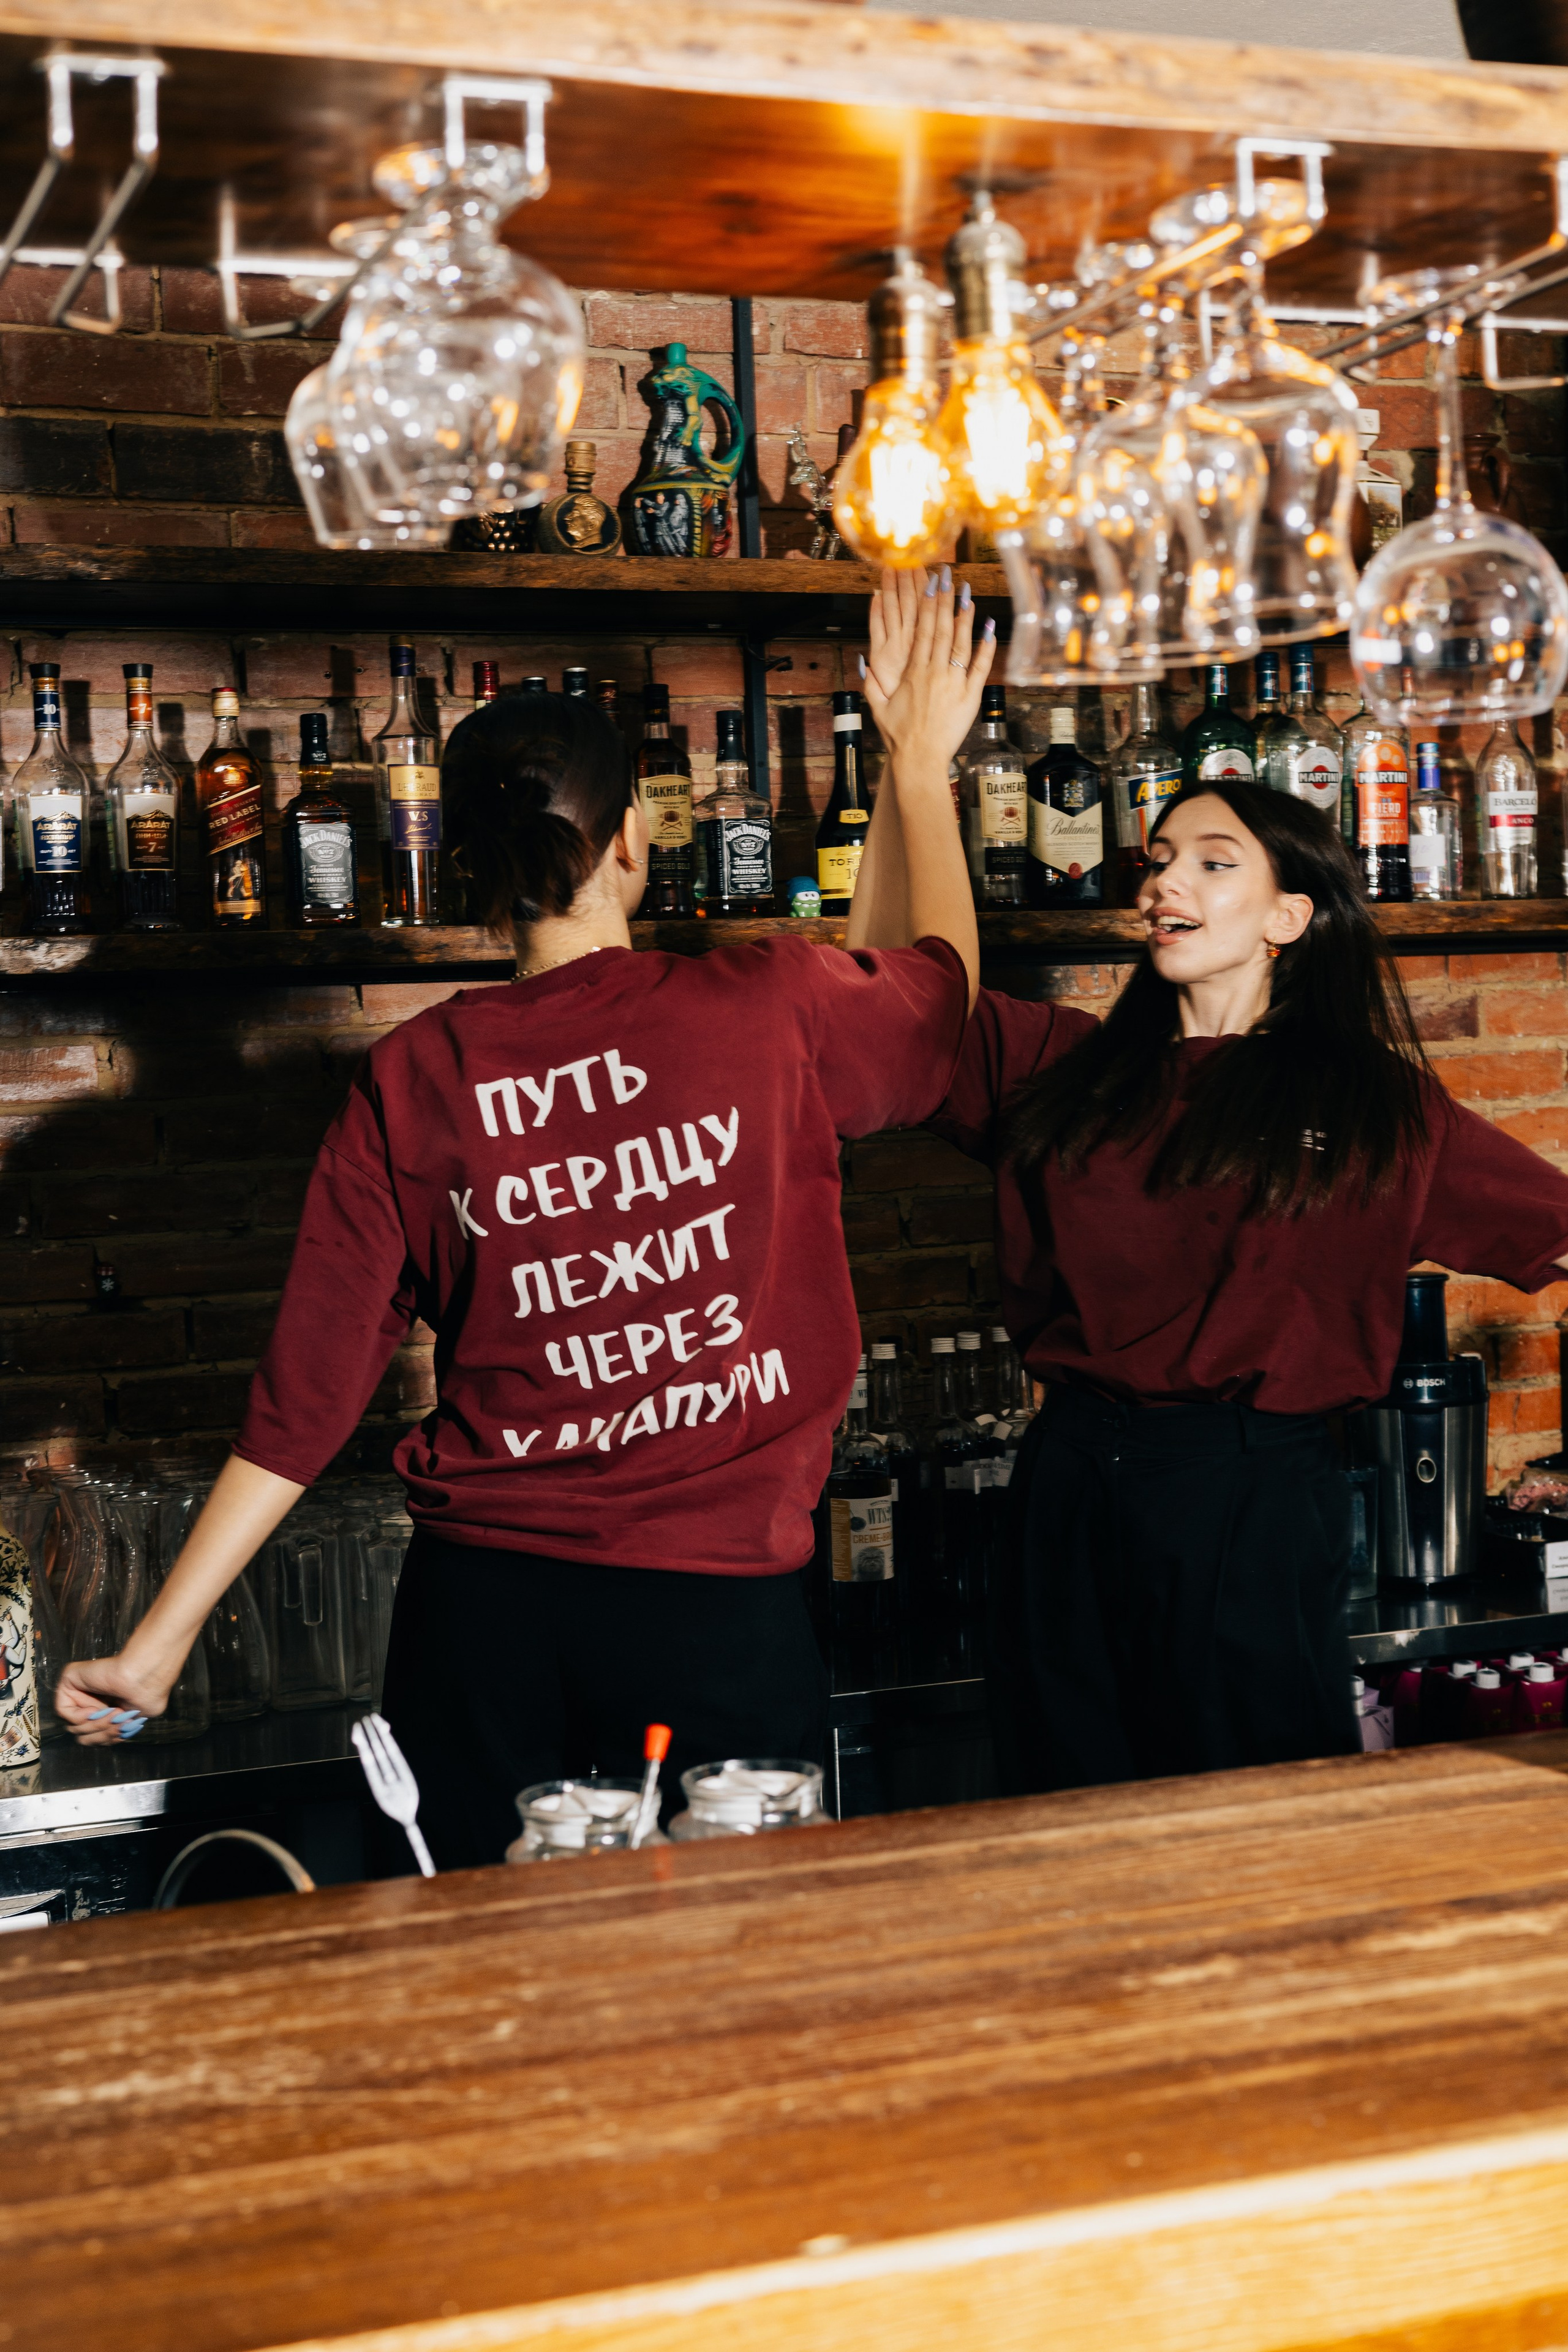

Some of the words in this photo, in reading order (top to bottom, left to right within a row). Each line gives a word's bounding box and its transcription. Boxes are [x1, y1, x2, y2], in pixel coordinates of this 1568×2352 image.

[42, 704, 56, 714] 10
[137, 703, 147, 714] 7
[1298, 772, 1338, 782] MARTINI
[1359, 772, 1408, 783] MARTINI
[398, 783, 437, 792] LHRAUD
[208, 816, 228, 829] RED
[229, 804, 261, 821] LABEL
[36, 821, 78, 831] ARARAT
[130, 820, 171, 829] ARARAT
[725, 826, 742, 842] JACK
[298, 832, 319, 849] JACK
[51, 846, 67, 857] 10
[148, 842, 157, 853] 7
[733, 857, 764, 865] Tennessee
[308, 865, 345, 874] Tennessee
[475, 1049, 647, 1137] ПУТЬ
[449, 1188, 489, 1240] К
[496, 1106, 739, 1225] СЕРДЦУ
[511, 1203, 736, 1319] ЛЕЖИТ
[545, 1294, 744, 1390] ЧЕРЕЗ
[1416, 1378, 1446, 1387] BOSCH
